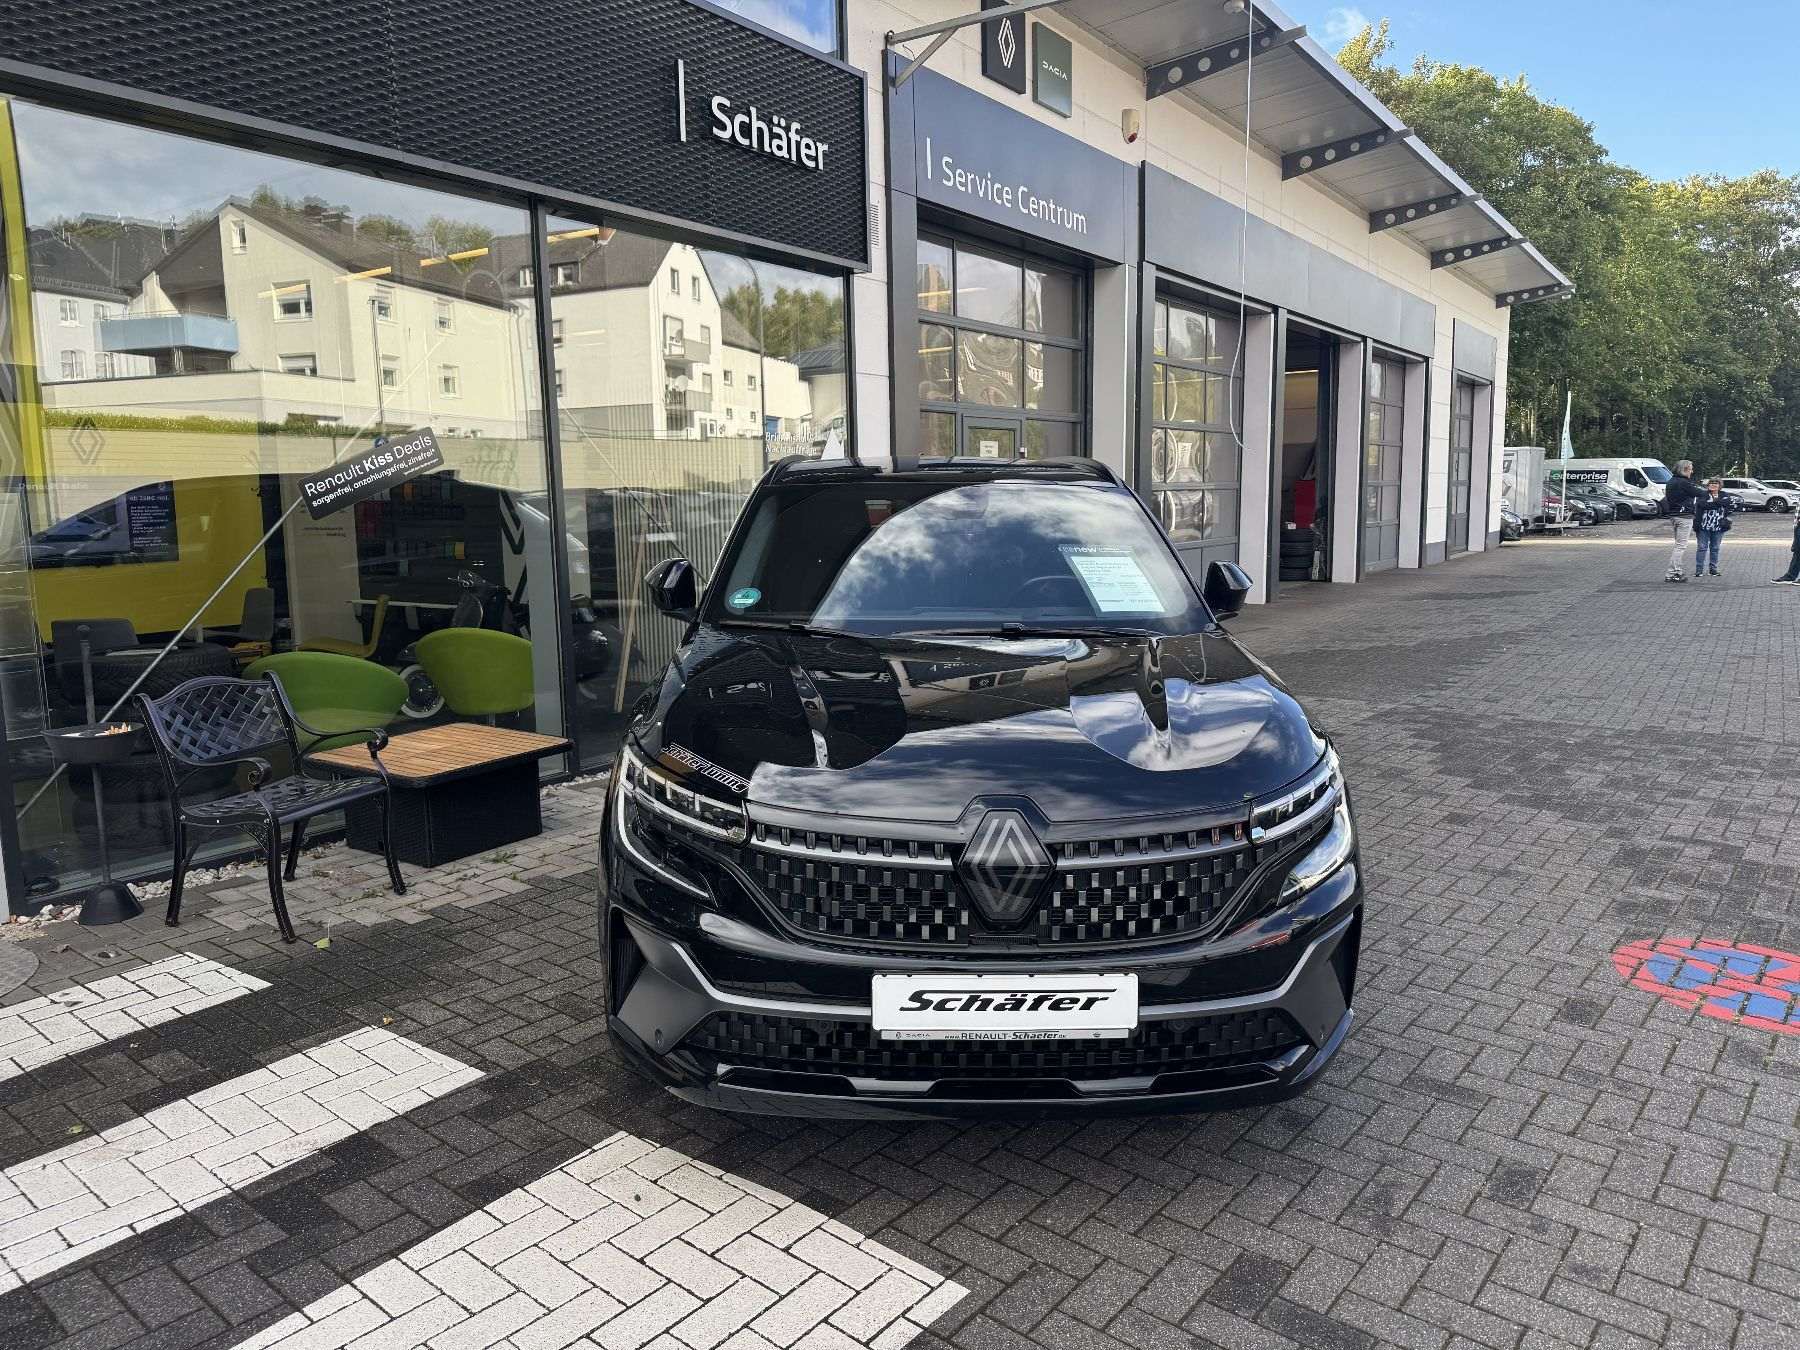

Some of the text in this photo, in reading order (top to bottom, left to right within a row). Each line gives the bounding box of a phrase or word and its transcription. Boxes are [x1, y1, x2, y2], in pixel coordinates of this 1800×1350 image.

[1042, 60, 1068, 80] DACIA
[711, 95, 829, 171] Schäfer
[941, 155, 1087, 234] Service Centrum
[304, 464, 364, 496] Renault
[362, 452, 393, 473] Kiss
[393, 435, 432, 459] Deals
[899, 989, 1117, 1011] Schäfer
